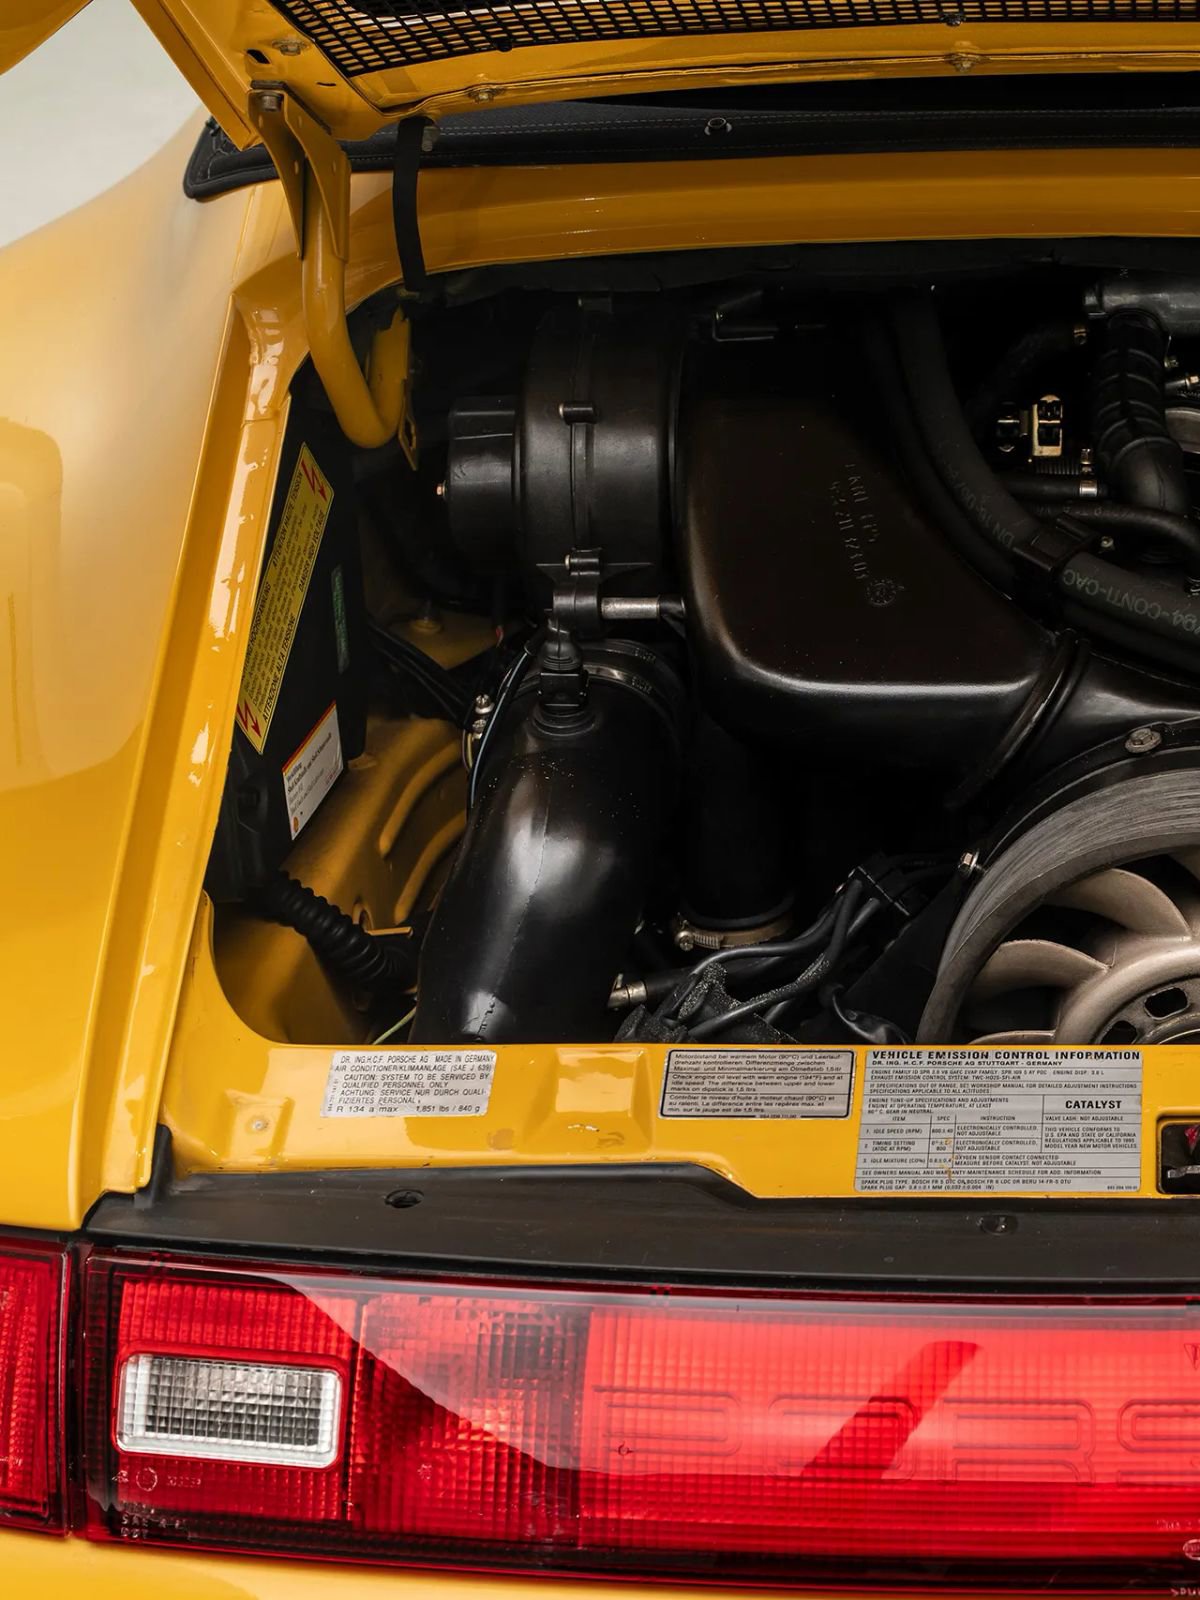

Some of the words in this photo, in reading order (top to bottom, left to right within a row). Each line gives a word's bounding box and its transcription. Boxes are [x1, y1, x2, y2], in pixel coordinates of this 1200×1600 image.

[263, 675, 279, 722] ATTENZIONE
[276, 654, 286, 675] ALTA
[387, 1055, 416, 1063] PORSCHE
[419, 1055, 429, 1063] AG
[435, 1055, 452, 1063] MADE
[455, 1055, 462, 1063] IN
[464, 1054, 495, 1063] GERMANY
[872, 1051, 923, 1059] VEHICLE
[928, 1051, 989, 1059] EMISSION
[994, 1051, 1050, 1059] CONTROL
[1055, 1051, 1140, 1059] INFORMATION
[344, 1073, 377, 1081] CAUTION:
[381, 1073, 410, 1081] SYSTEM
[414, 1073, 424, 1081] TO
[427, 1073, 437, 1081] BE
[440, 1073, 477, 1081] SERVICED
[479, 1072, 490, 1080] BY
[342, 1081, 379, 1089] QUALIFIED
[382, 1081, 425, 1089] PERSONNEL
[429, 1081, 449, 1089] ONLY
[1065, 1100, 1122, 1109] CATALYST
[336, 1105, 344, 1113] R
[349, 1105, 365, 1113] 134
[438, 1105, 450, 1113] lbs
[458, 1105, 473, 1113] 840
[475, 1106, 481, 1114] g
